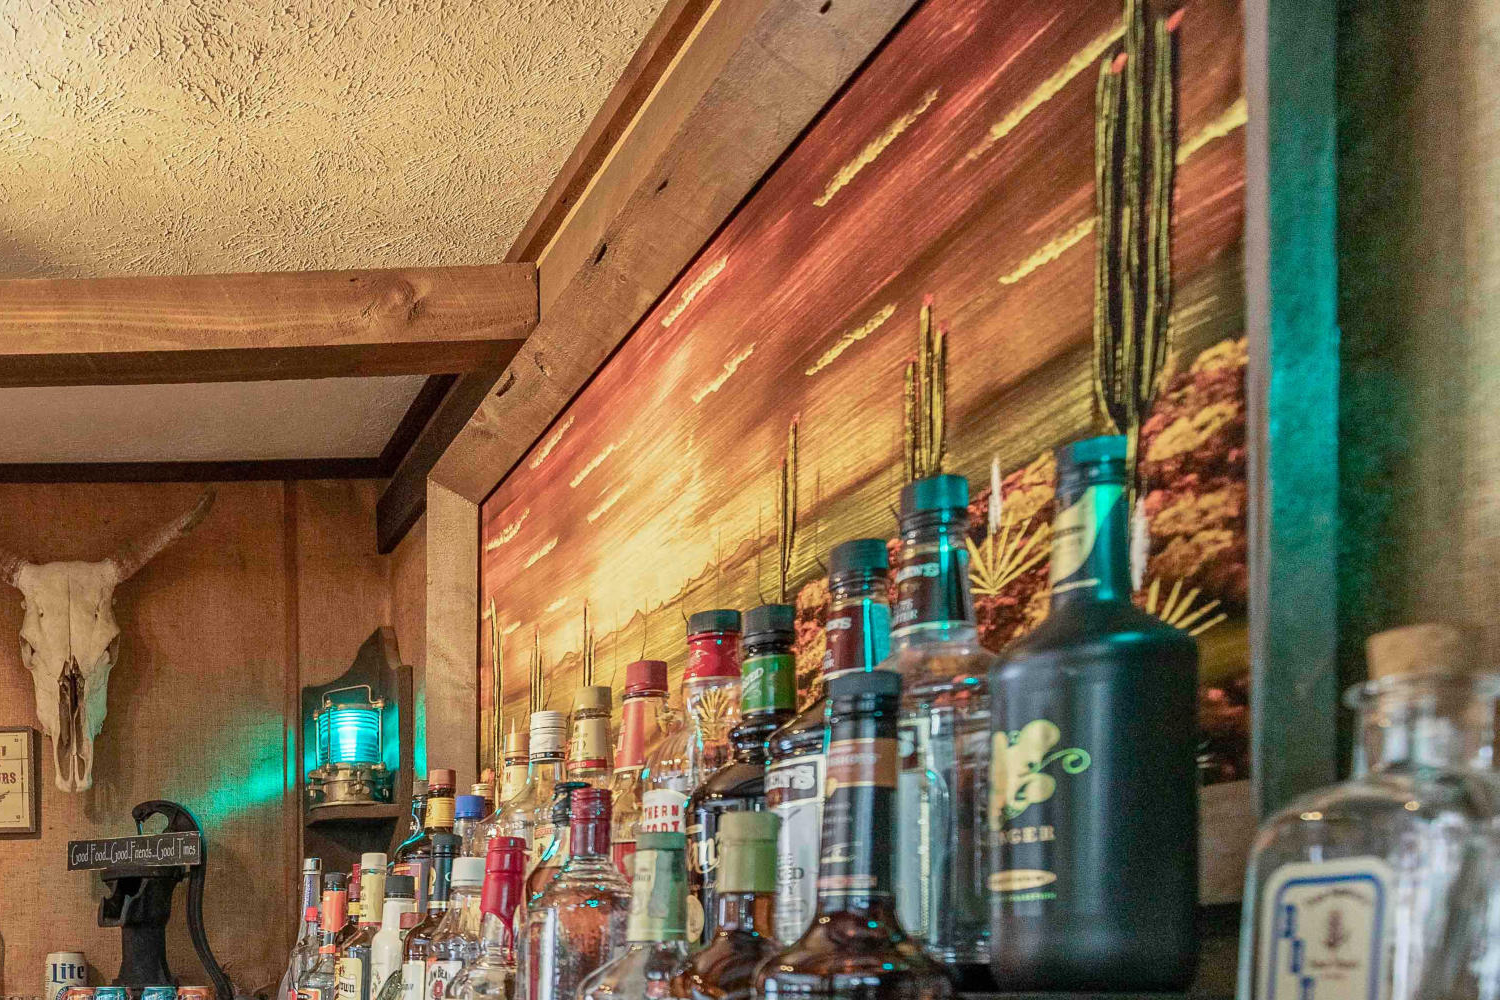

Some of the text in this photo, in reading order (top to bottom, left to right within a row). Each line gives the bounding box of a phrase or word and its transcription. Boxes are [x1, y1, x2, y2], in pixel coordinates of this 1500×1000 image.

[71, 844, 89, 865] Good
[111, 841, 129, 863] Good
[156, 838, 175, 860] Good
[51, 963, 85, 984] Lite
